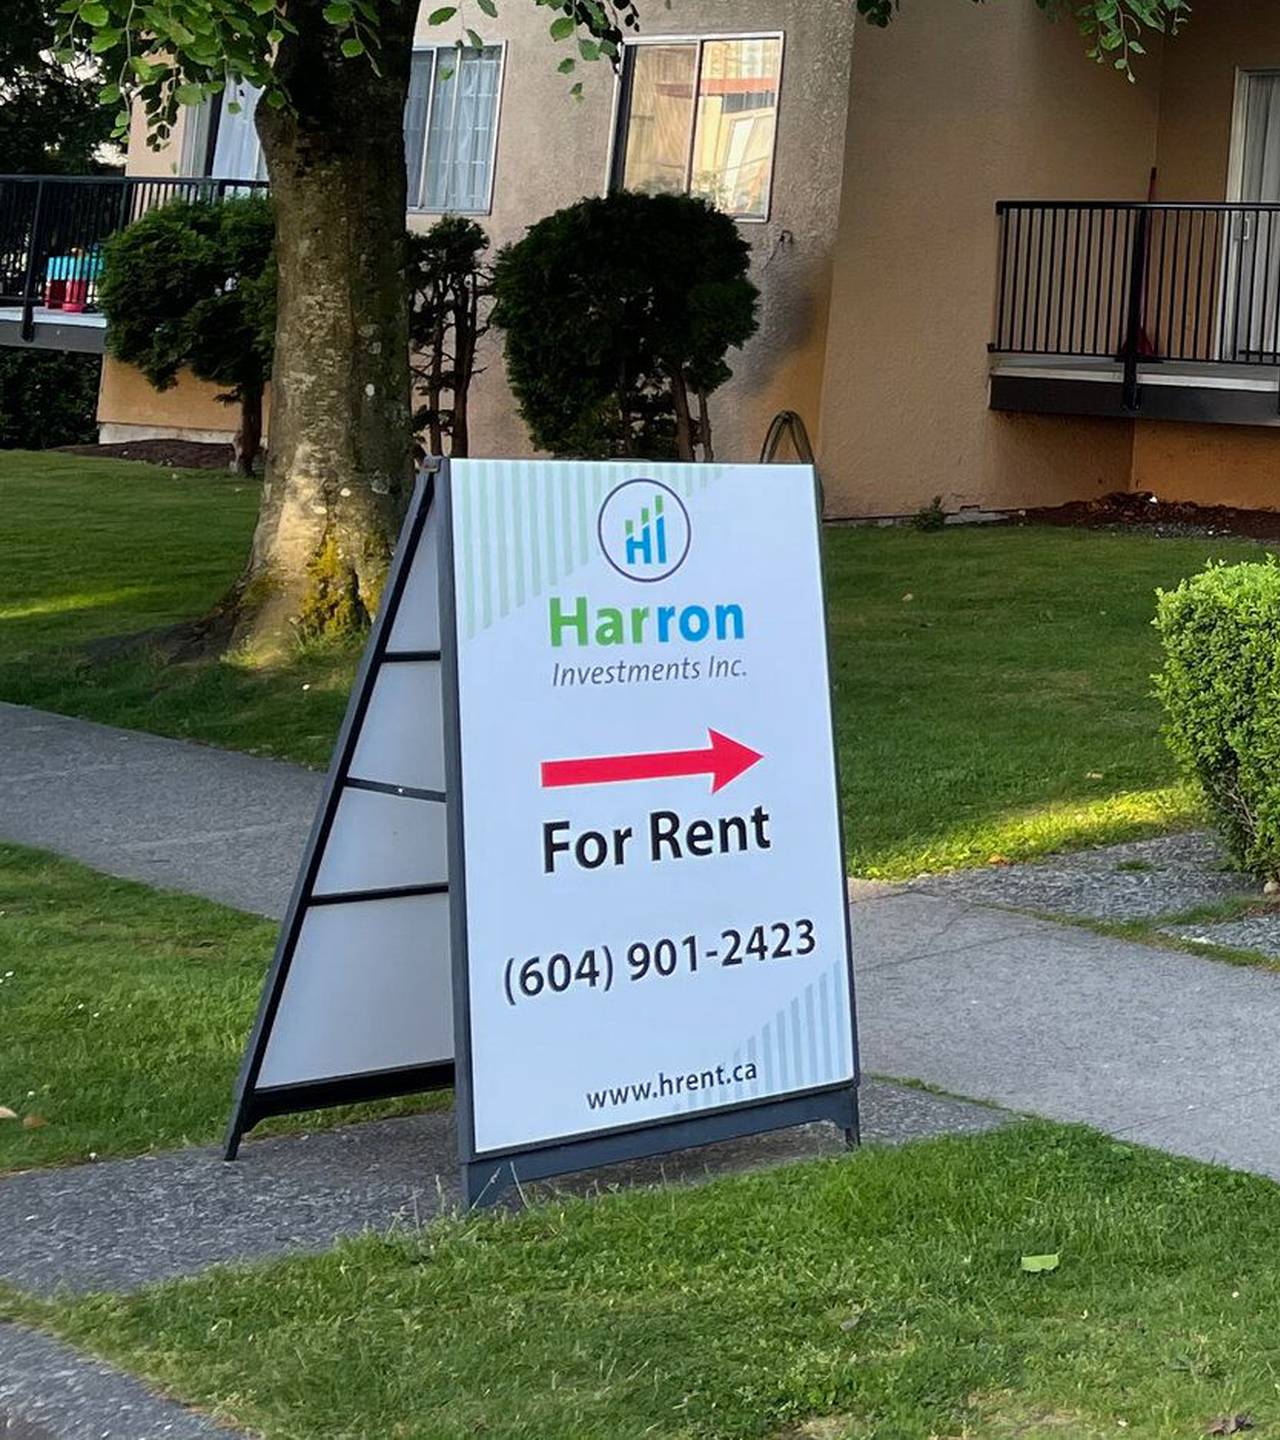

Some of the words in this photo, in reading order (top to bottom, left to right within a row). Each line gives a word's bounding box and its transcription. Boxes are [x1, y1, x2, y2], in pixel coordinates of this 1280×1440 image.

[549, 597, 745, 647] Harron
[552, 657, 700, 687] Investments
[708, 655, 748, 678] Inc.
[542, 820, 632, 873] For
[650, 805, 771, 861] Rent
[504, 946, 613, 1005] (604)
[627, 918, 816, 981] 901-2423
[587, 1062, 757, 1109] www.hrent.ca
